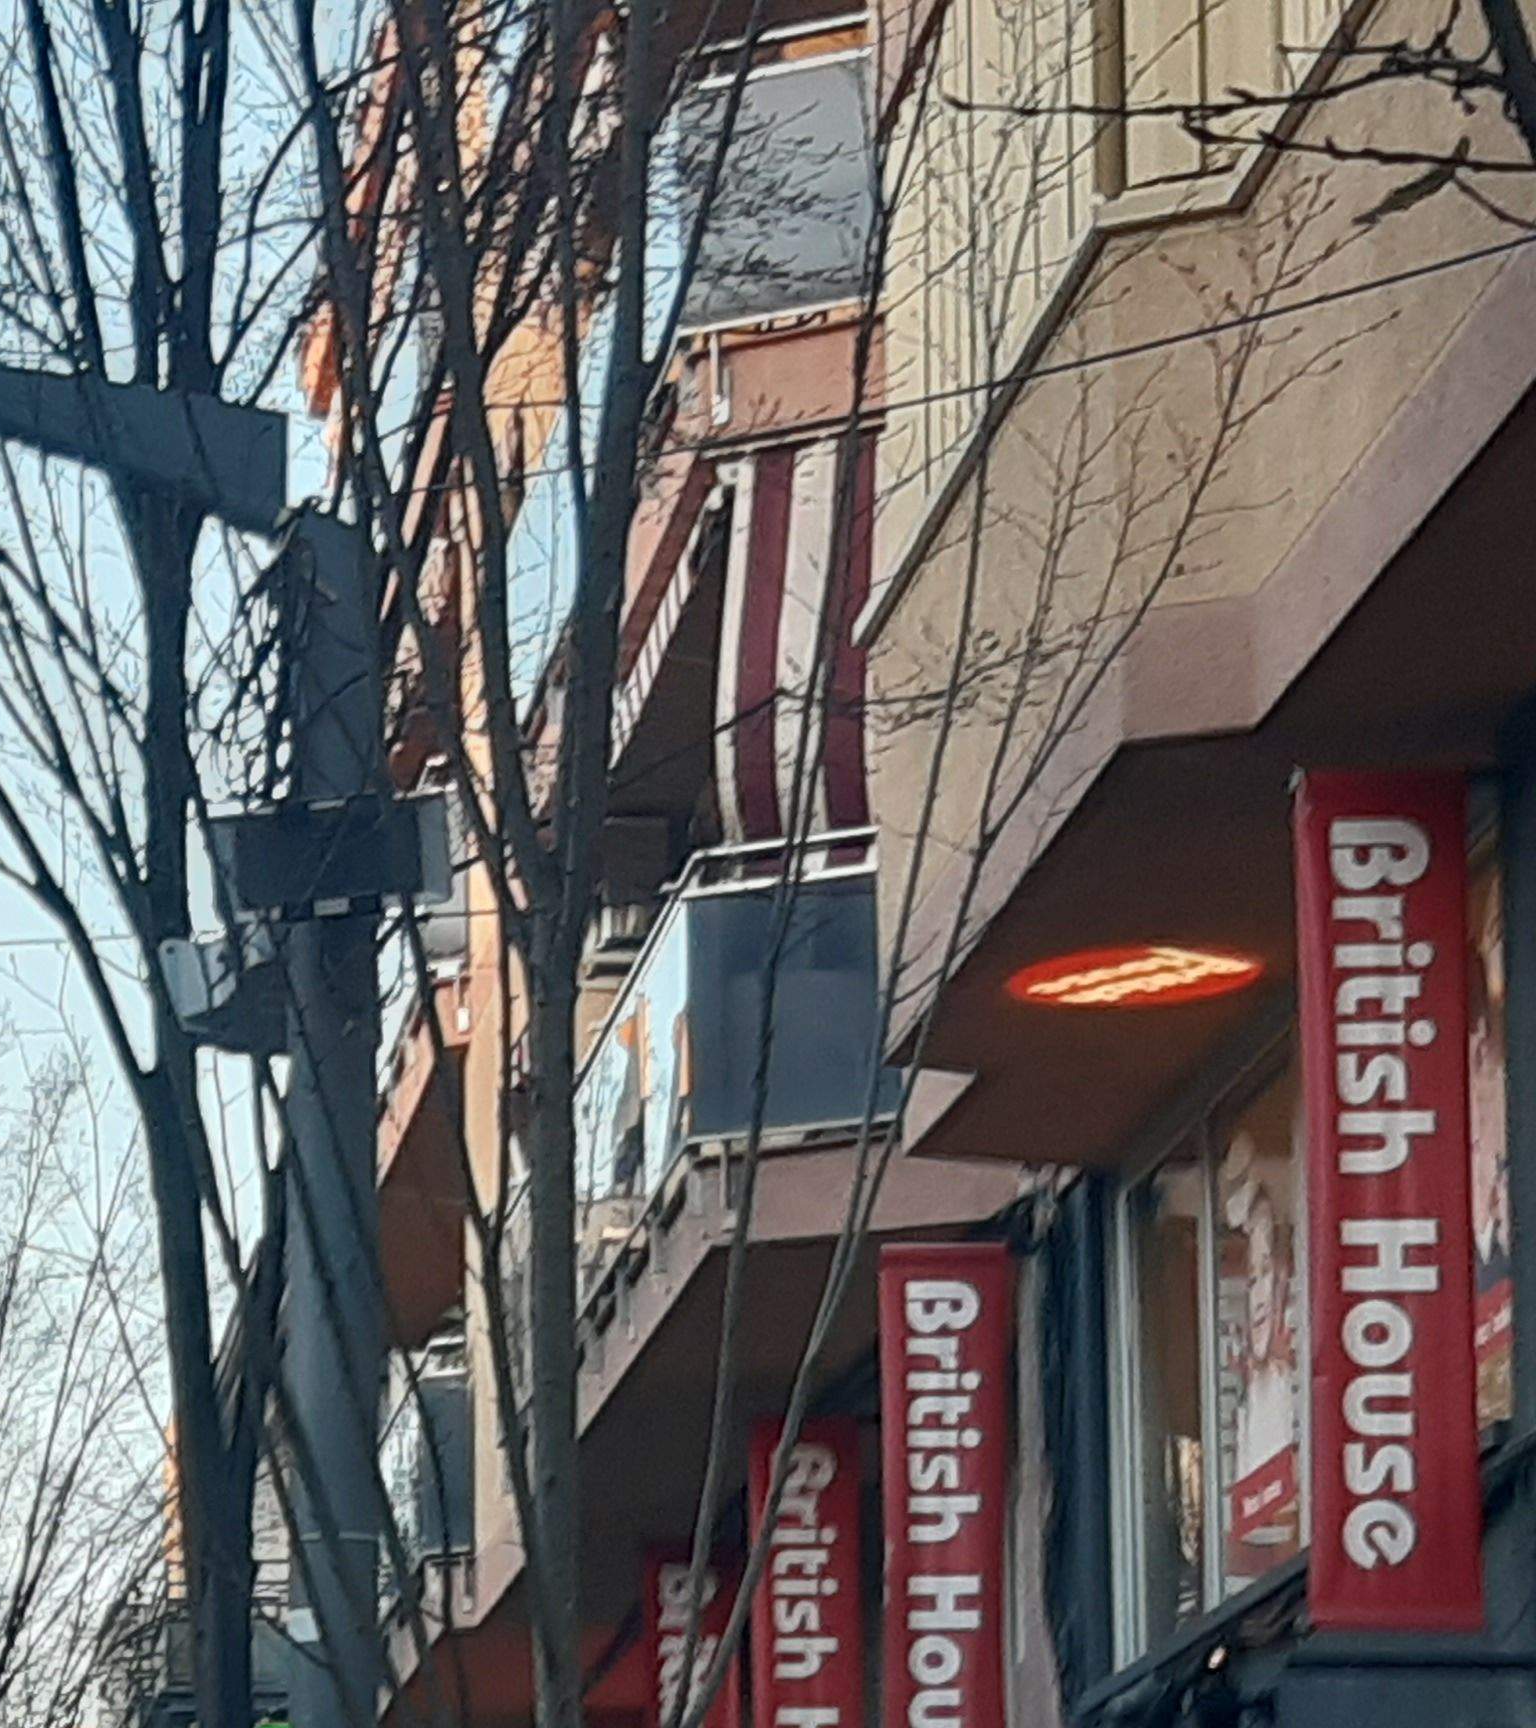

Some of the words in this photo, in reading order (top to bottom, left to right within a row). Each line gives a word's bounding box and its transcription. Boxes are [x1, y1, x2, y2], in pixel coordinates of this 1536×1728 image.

[1330, 817, 1436, 1176] British
[903, 1278, 983, 1545] British
[1339, 1218, 1441, 1572] House
[772, 1443, 842, 1682] British
